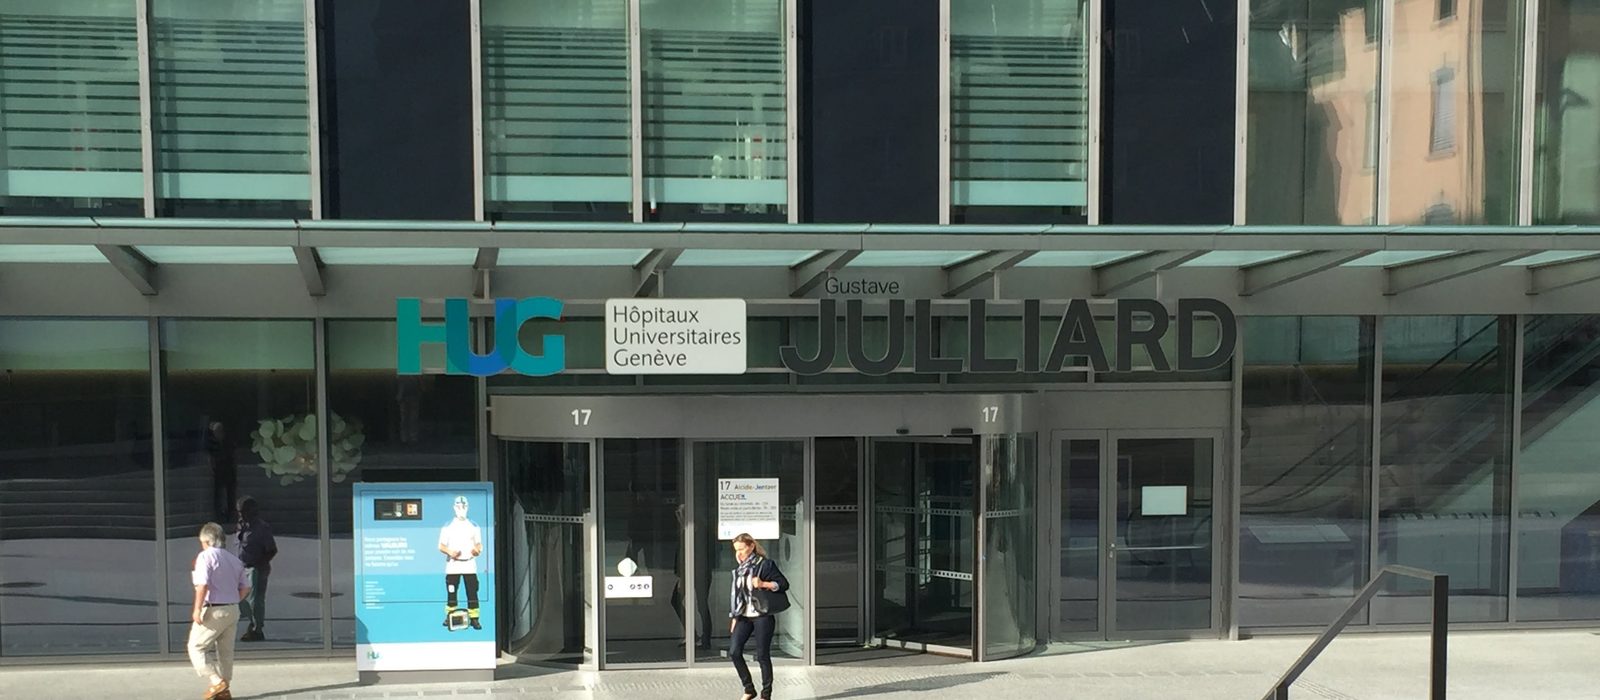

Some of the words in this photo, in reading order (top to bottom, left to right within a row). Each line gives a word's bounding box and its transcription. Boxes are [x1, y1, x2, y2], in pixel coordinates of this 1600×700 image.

[824, 277, 900, 295] Gustave
[613, 305, 699, 327] Hôpitaux
[396, 296, 566, 377] HUG
[613, 327, 741, 344] Universitaires
[779, 297, 1238, 376] JULLIARD
[613, 348, 687, 366] Genève
[571, 409, 592, 425] 17
[982, 406, 999, 423] 17
[720, 481, 731, 490] 17
